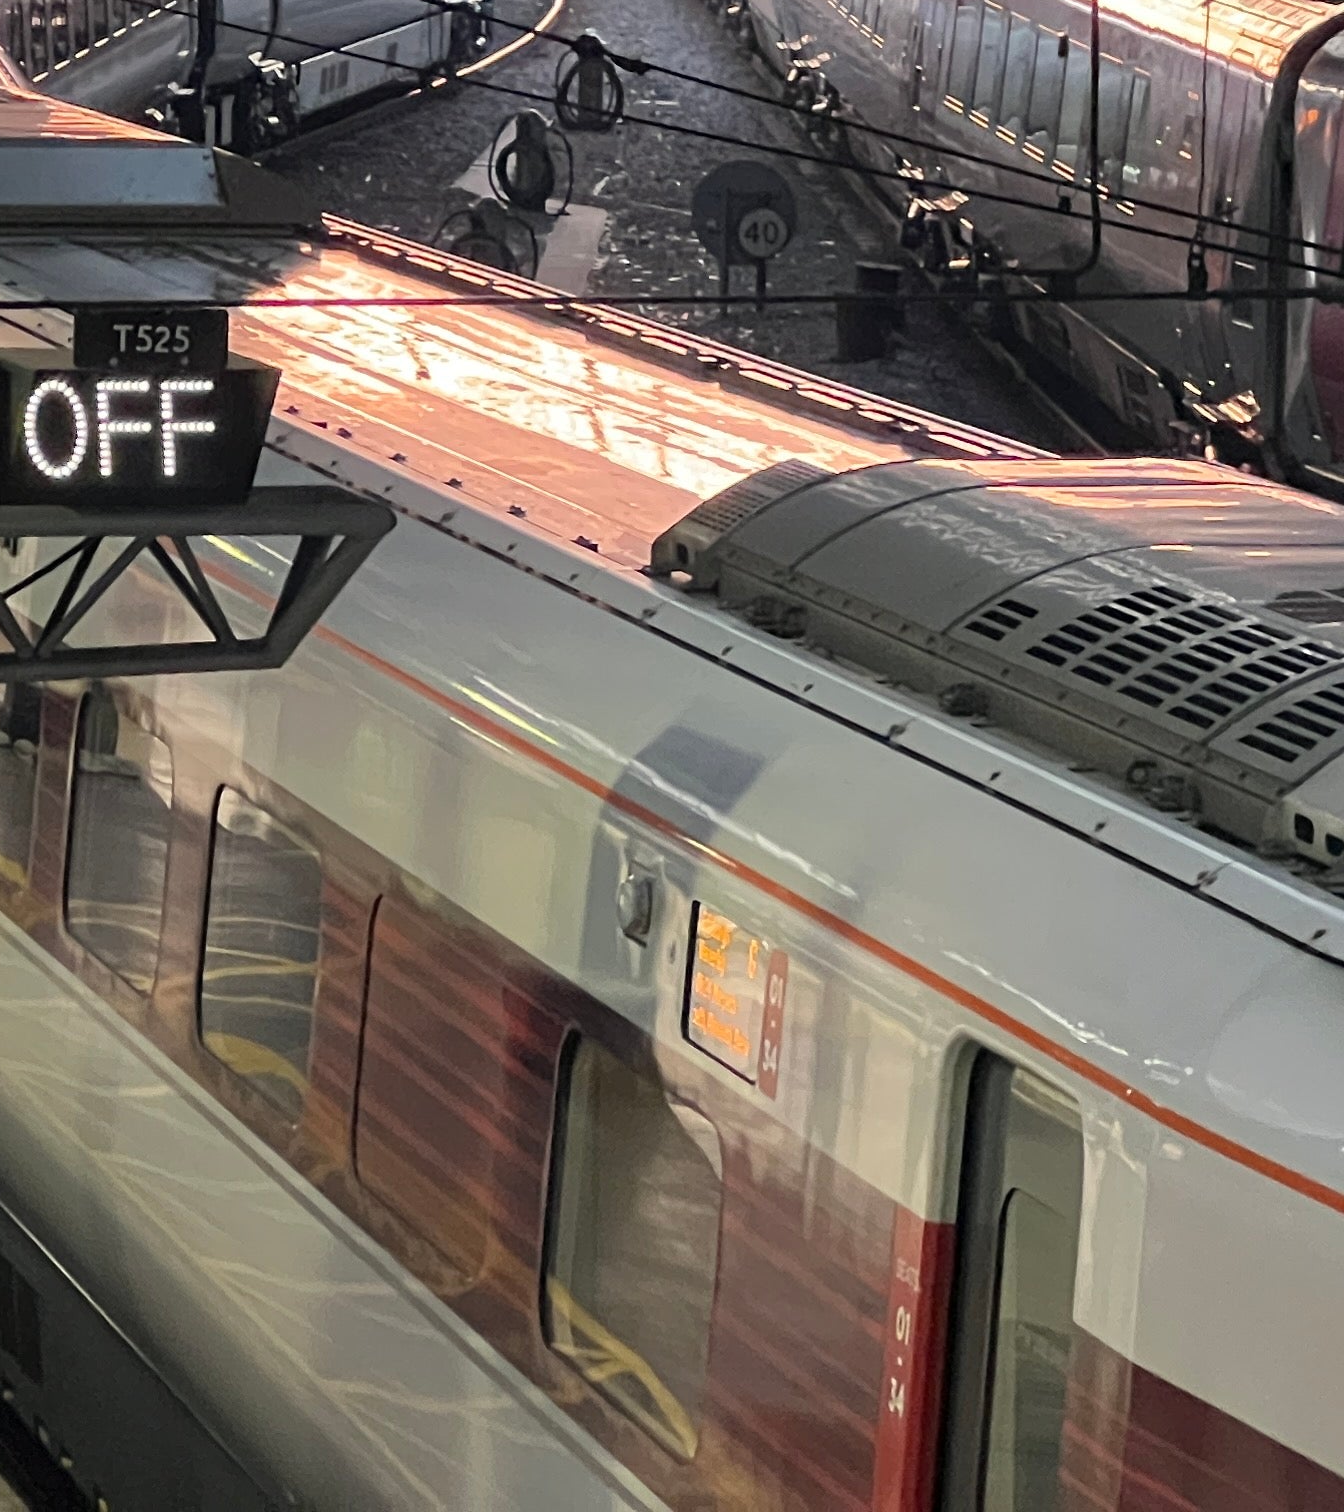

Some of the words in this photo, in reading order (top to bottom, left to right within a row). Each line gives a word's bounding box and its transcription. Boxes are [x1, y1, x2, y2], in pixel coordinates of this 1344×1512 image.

[743, 220, 779, 245] 40
[112, 323, 191, 355] T525
[24, 377, 217, 480] OFF
